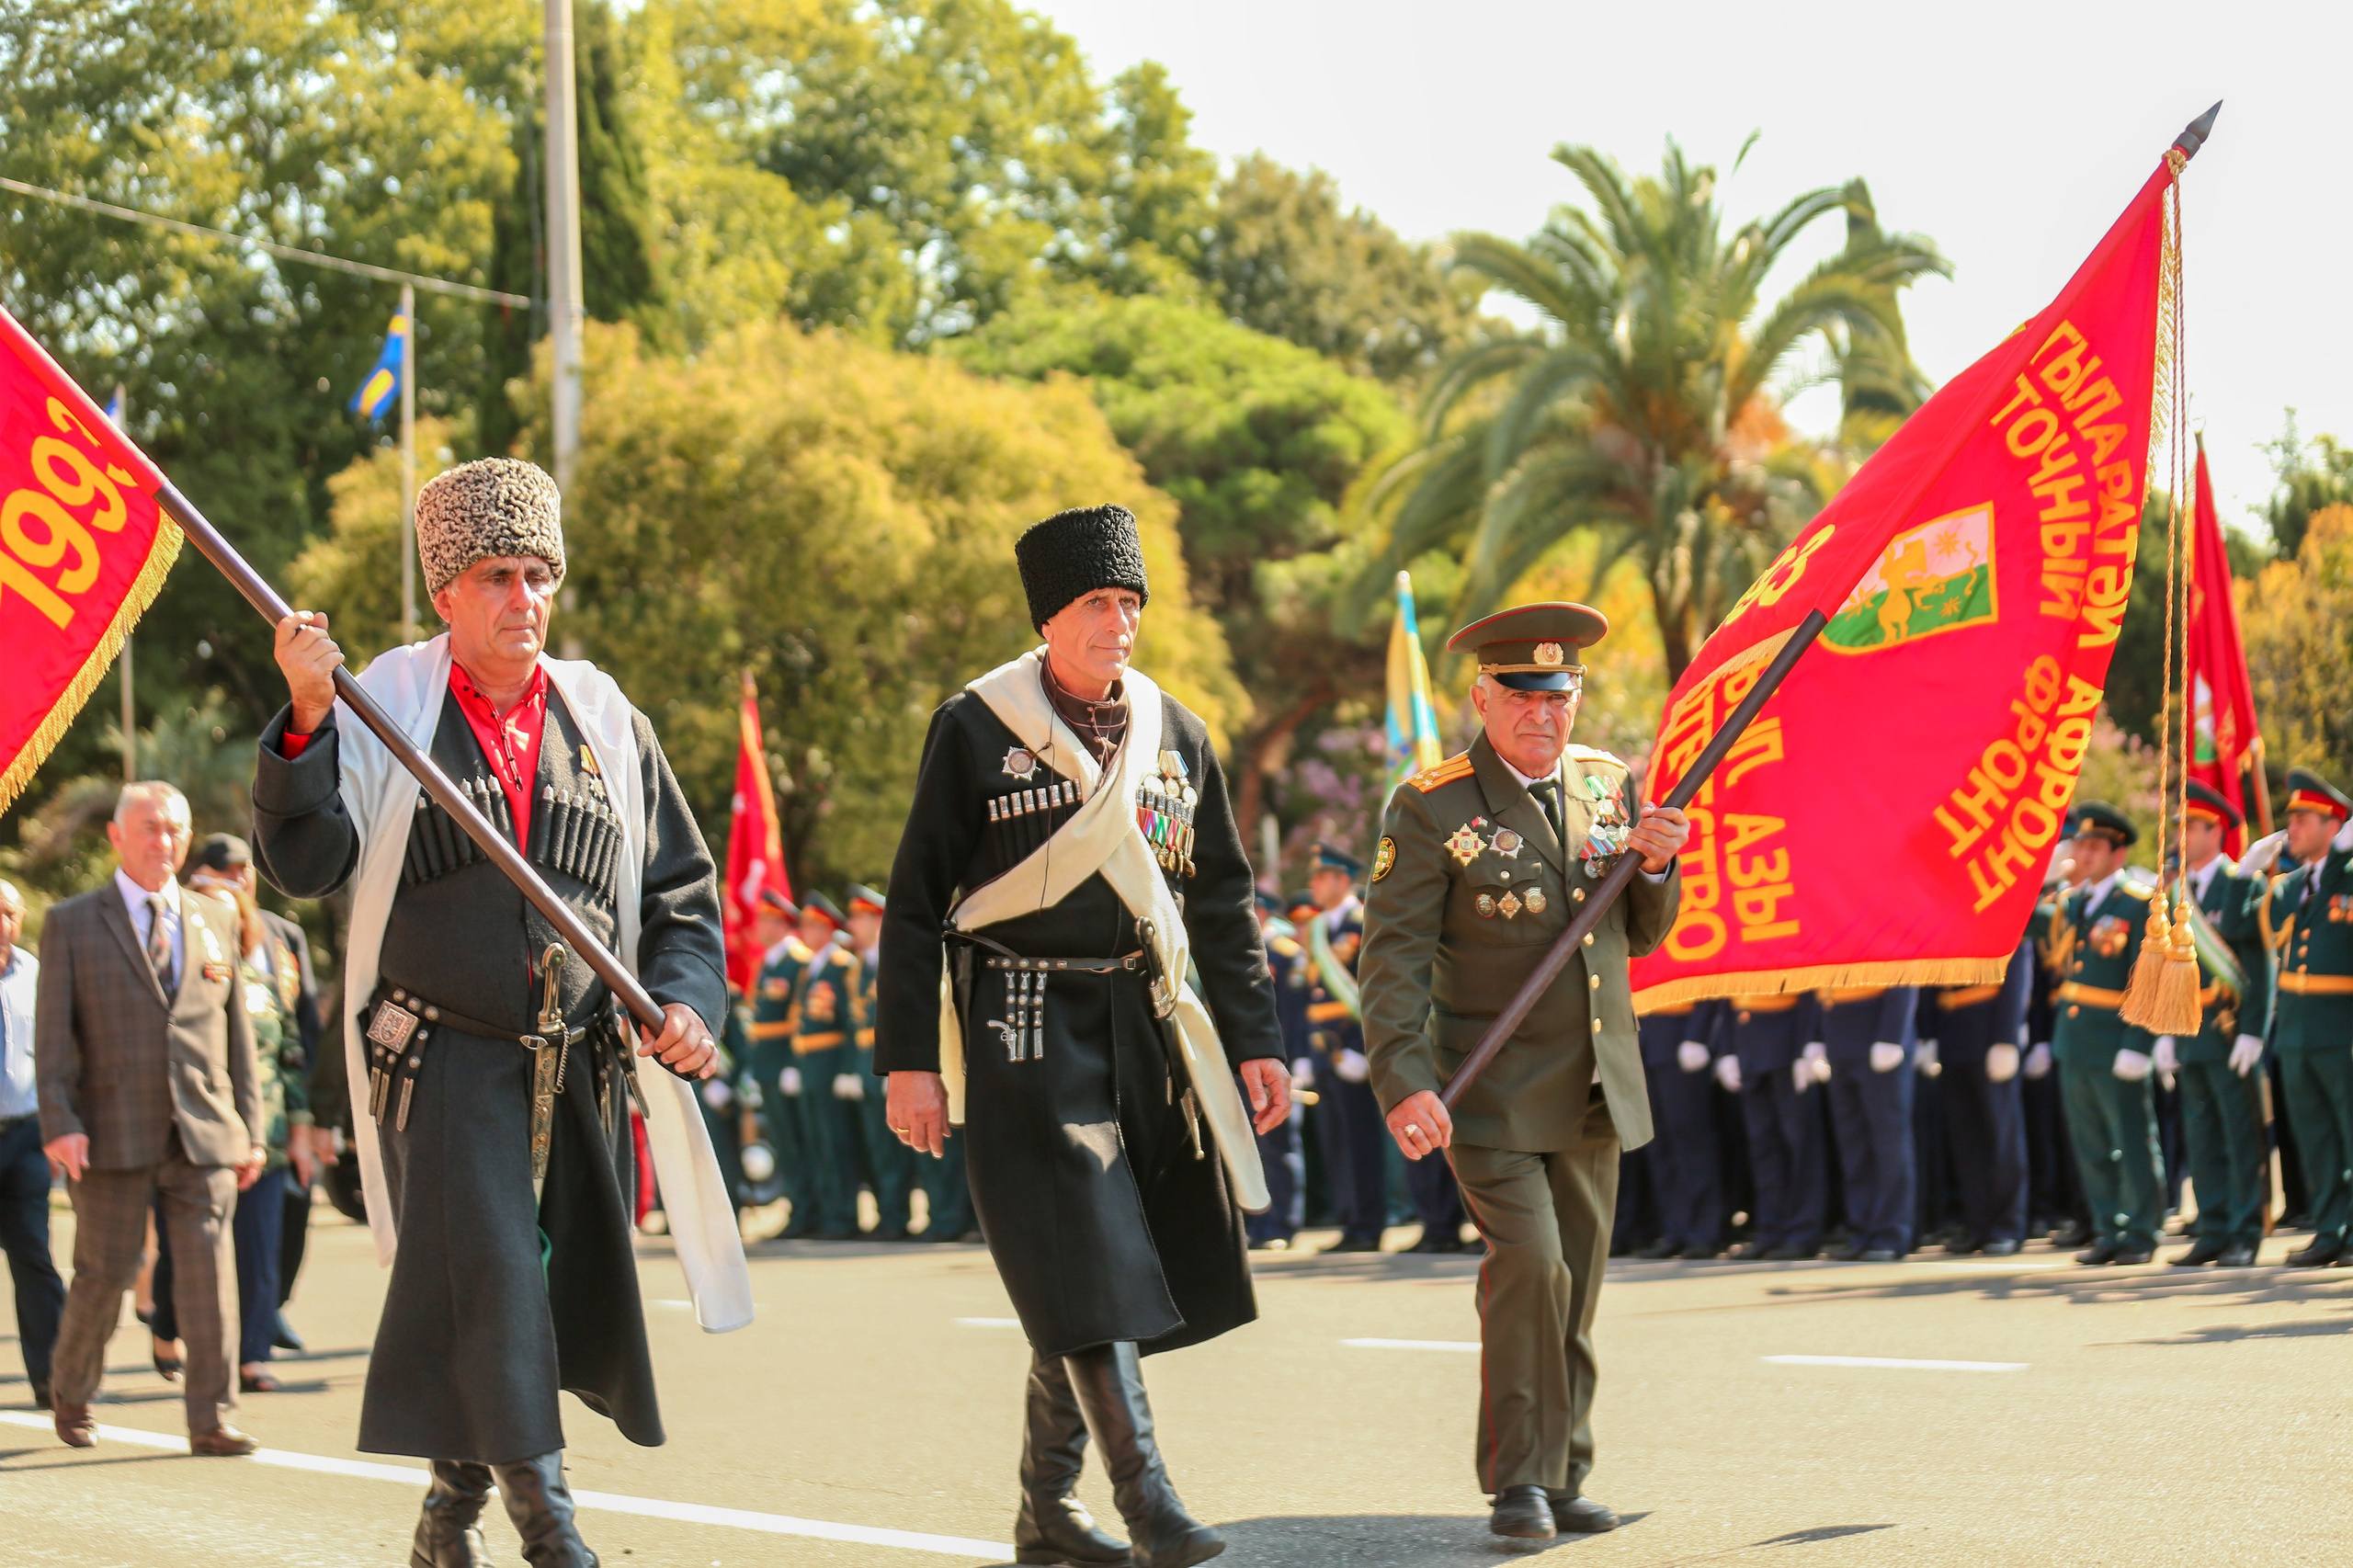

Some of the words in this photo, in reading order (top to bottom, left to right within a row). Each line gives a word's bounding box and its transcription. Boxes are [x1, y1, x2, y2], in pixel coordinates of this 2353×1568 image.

[1932, 654, 2062, 858] ФРОНТ
[1966, 673, 2105, 915] АФРОНТ
[1723, 812, 1800, 942] АЗЫ
